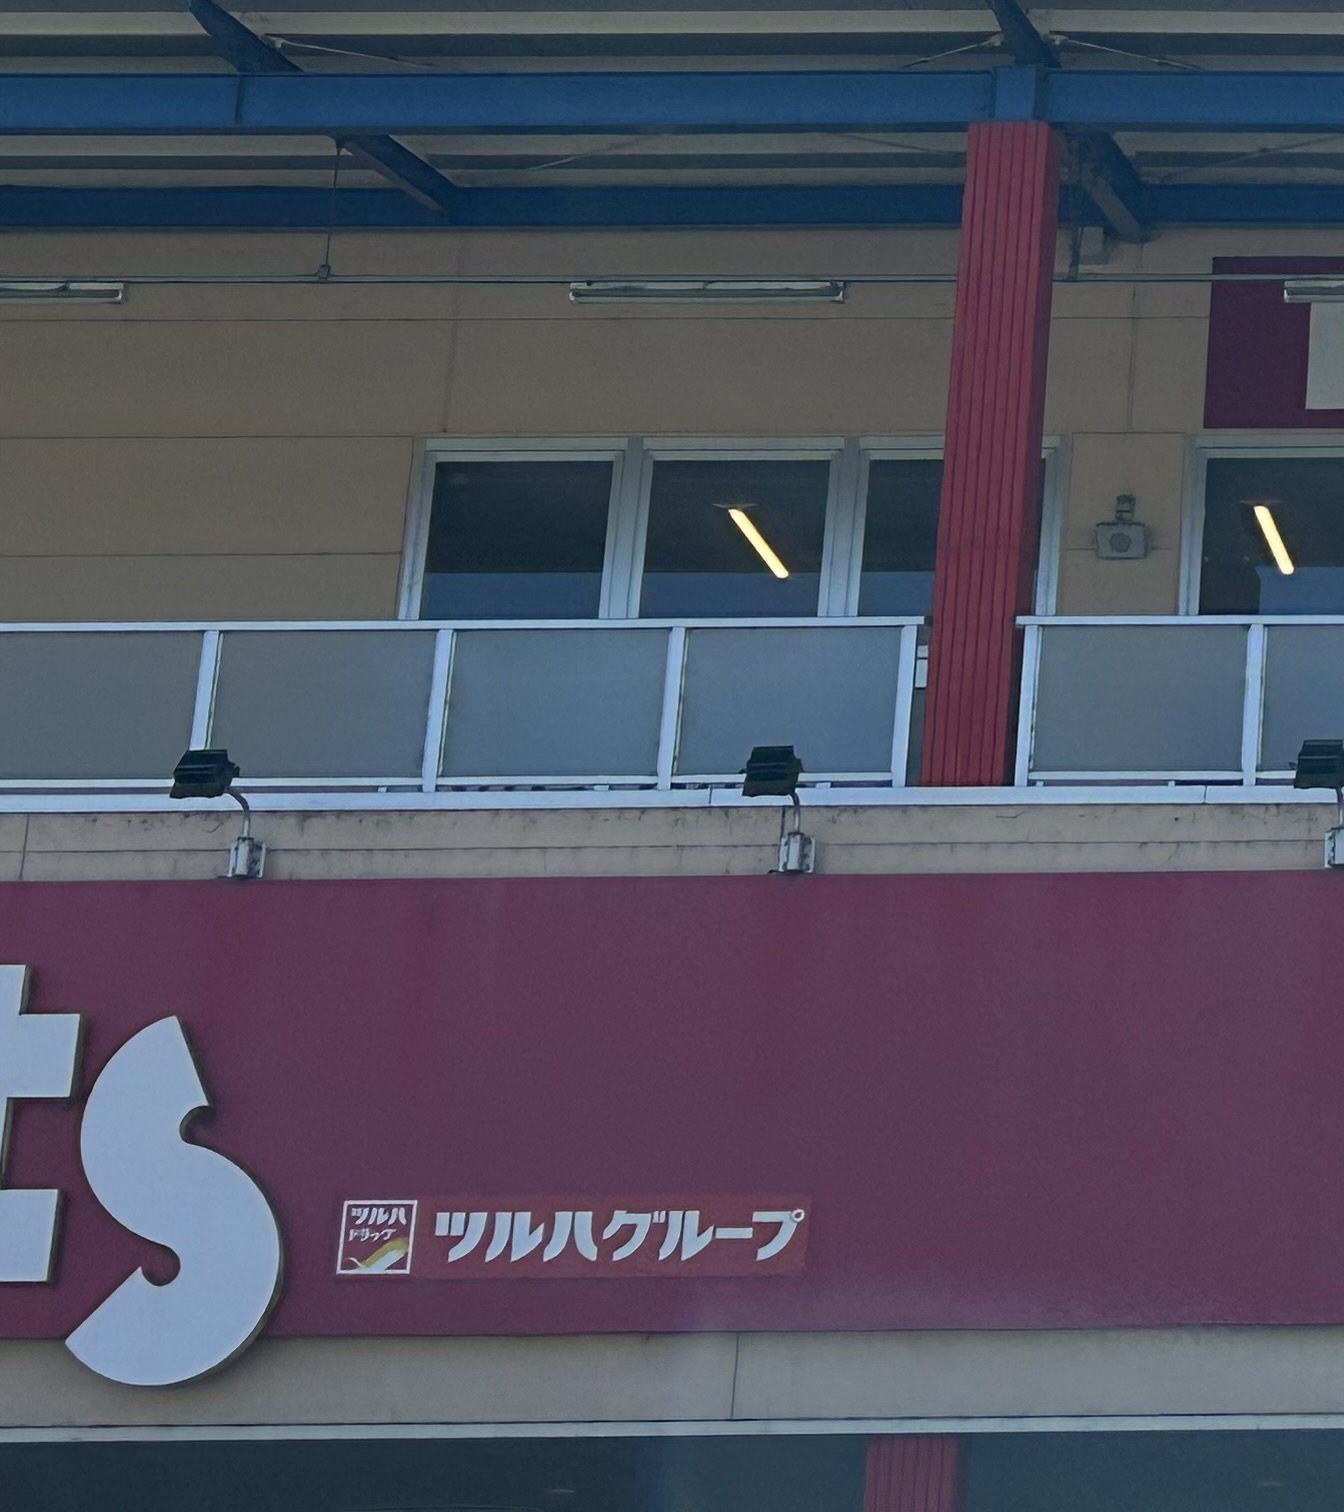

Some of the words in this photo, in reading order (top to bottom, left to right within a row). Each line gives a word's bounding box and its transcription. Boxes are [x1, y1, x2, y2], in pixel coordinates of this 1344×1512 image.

[351, 1207, 407, 1226] ツルハ
[434, 1209, 806, 1264] ツルハグループ
